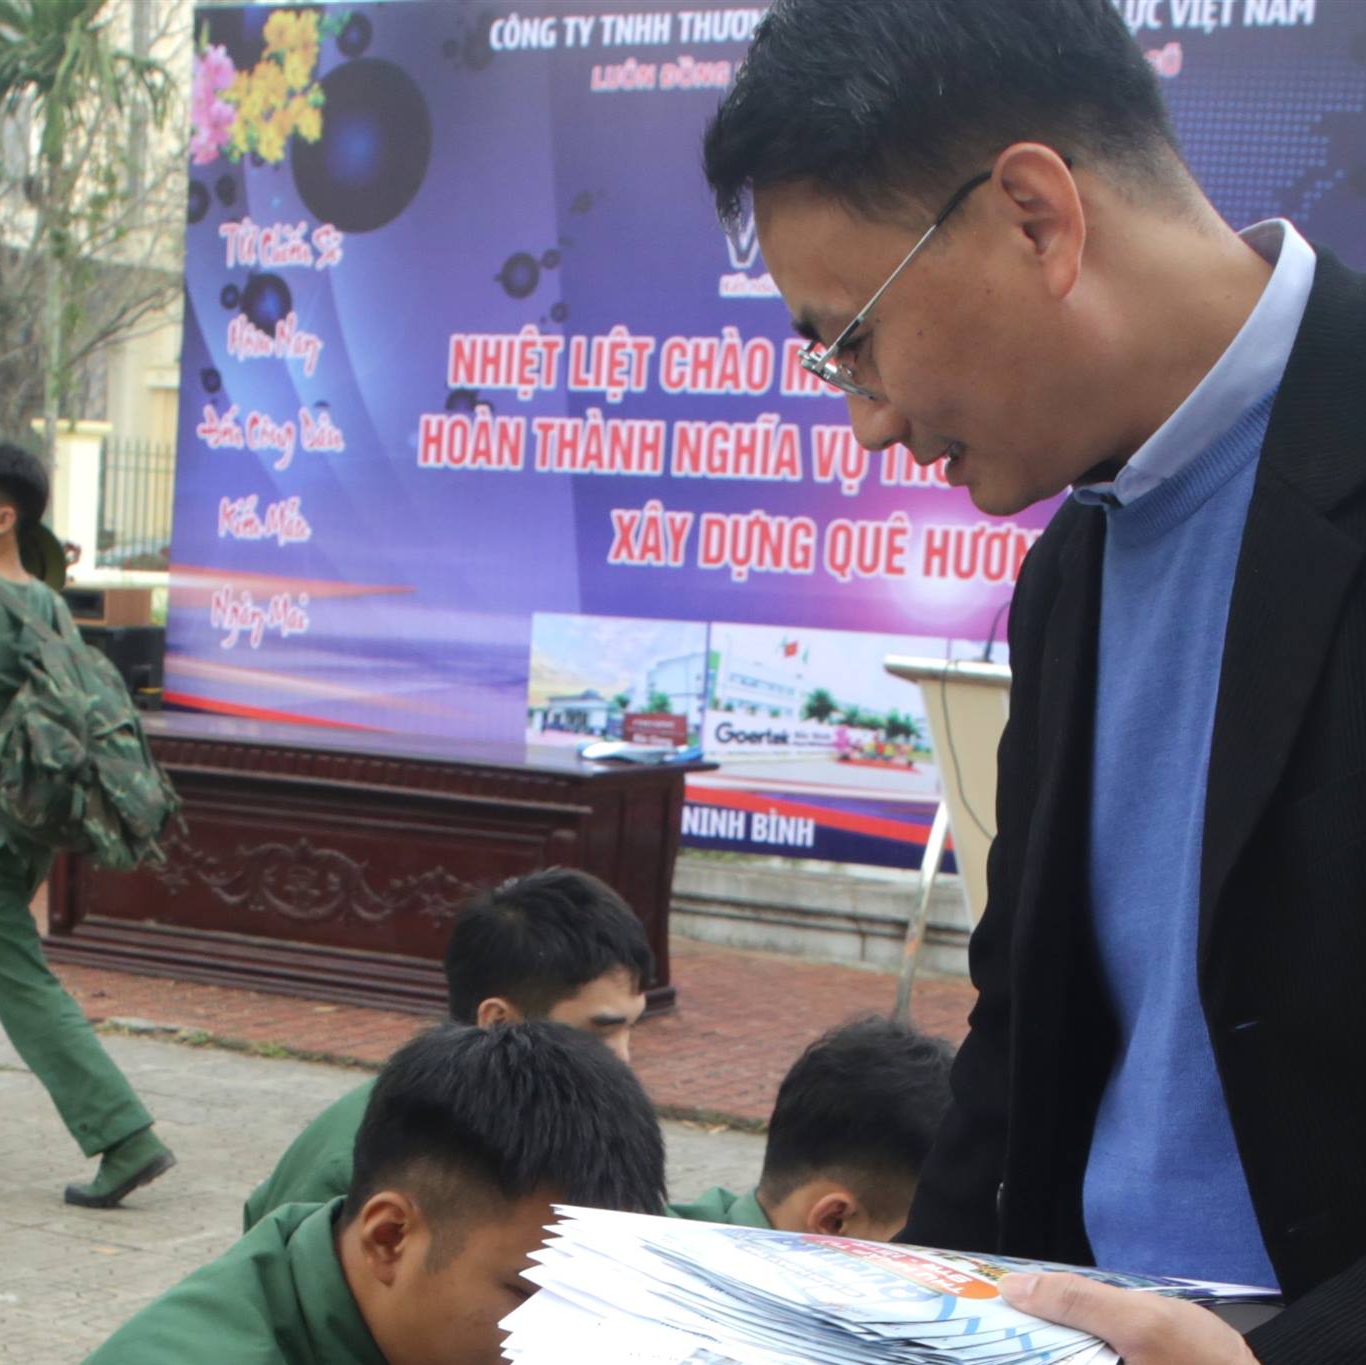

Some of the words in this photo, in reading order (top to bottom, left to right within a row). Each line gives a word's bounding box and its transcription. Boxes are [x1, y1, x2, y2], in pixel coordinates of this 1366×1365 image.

[489, 13, 557, 49] CÔNG
[563, 16, 595, 46] TY
[600, 13, 672, 46] TNHH
[678, 8, 766, 43] THƯƠ
[1243, 0, 1316, 28] NAM
[447, 325, 564, 400] NHIỆT
[568, 325, 654, 403] LIỆT
[660, 325, 774, 397] CHÀO
[418, 404, 526, 471] HOÀN
[533, 407, 665, 476] THÀNH
[671, 413, 802, 481] NGHĨA
[811, 425, 870, 495] VỤ
[607, 499, 694, 567] XÂY
[697, 509, 817, 582] DỰNG
[824, 511, 909, 582] QUÊ
[922, 522, 1047, 583] HƯƠN
[681, 806, 745, 840] NINH
[751, 808, 816, 848] BÌNH
